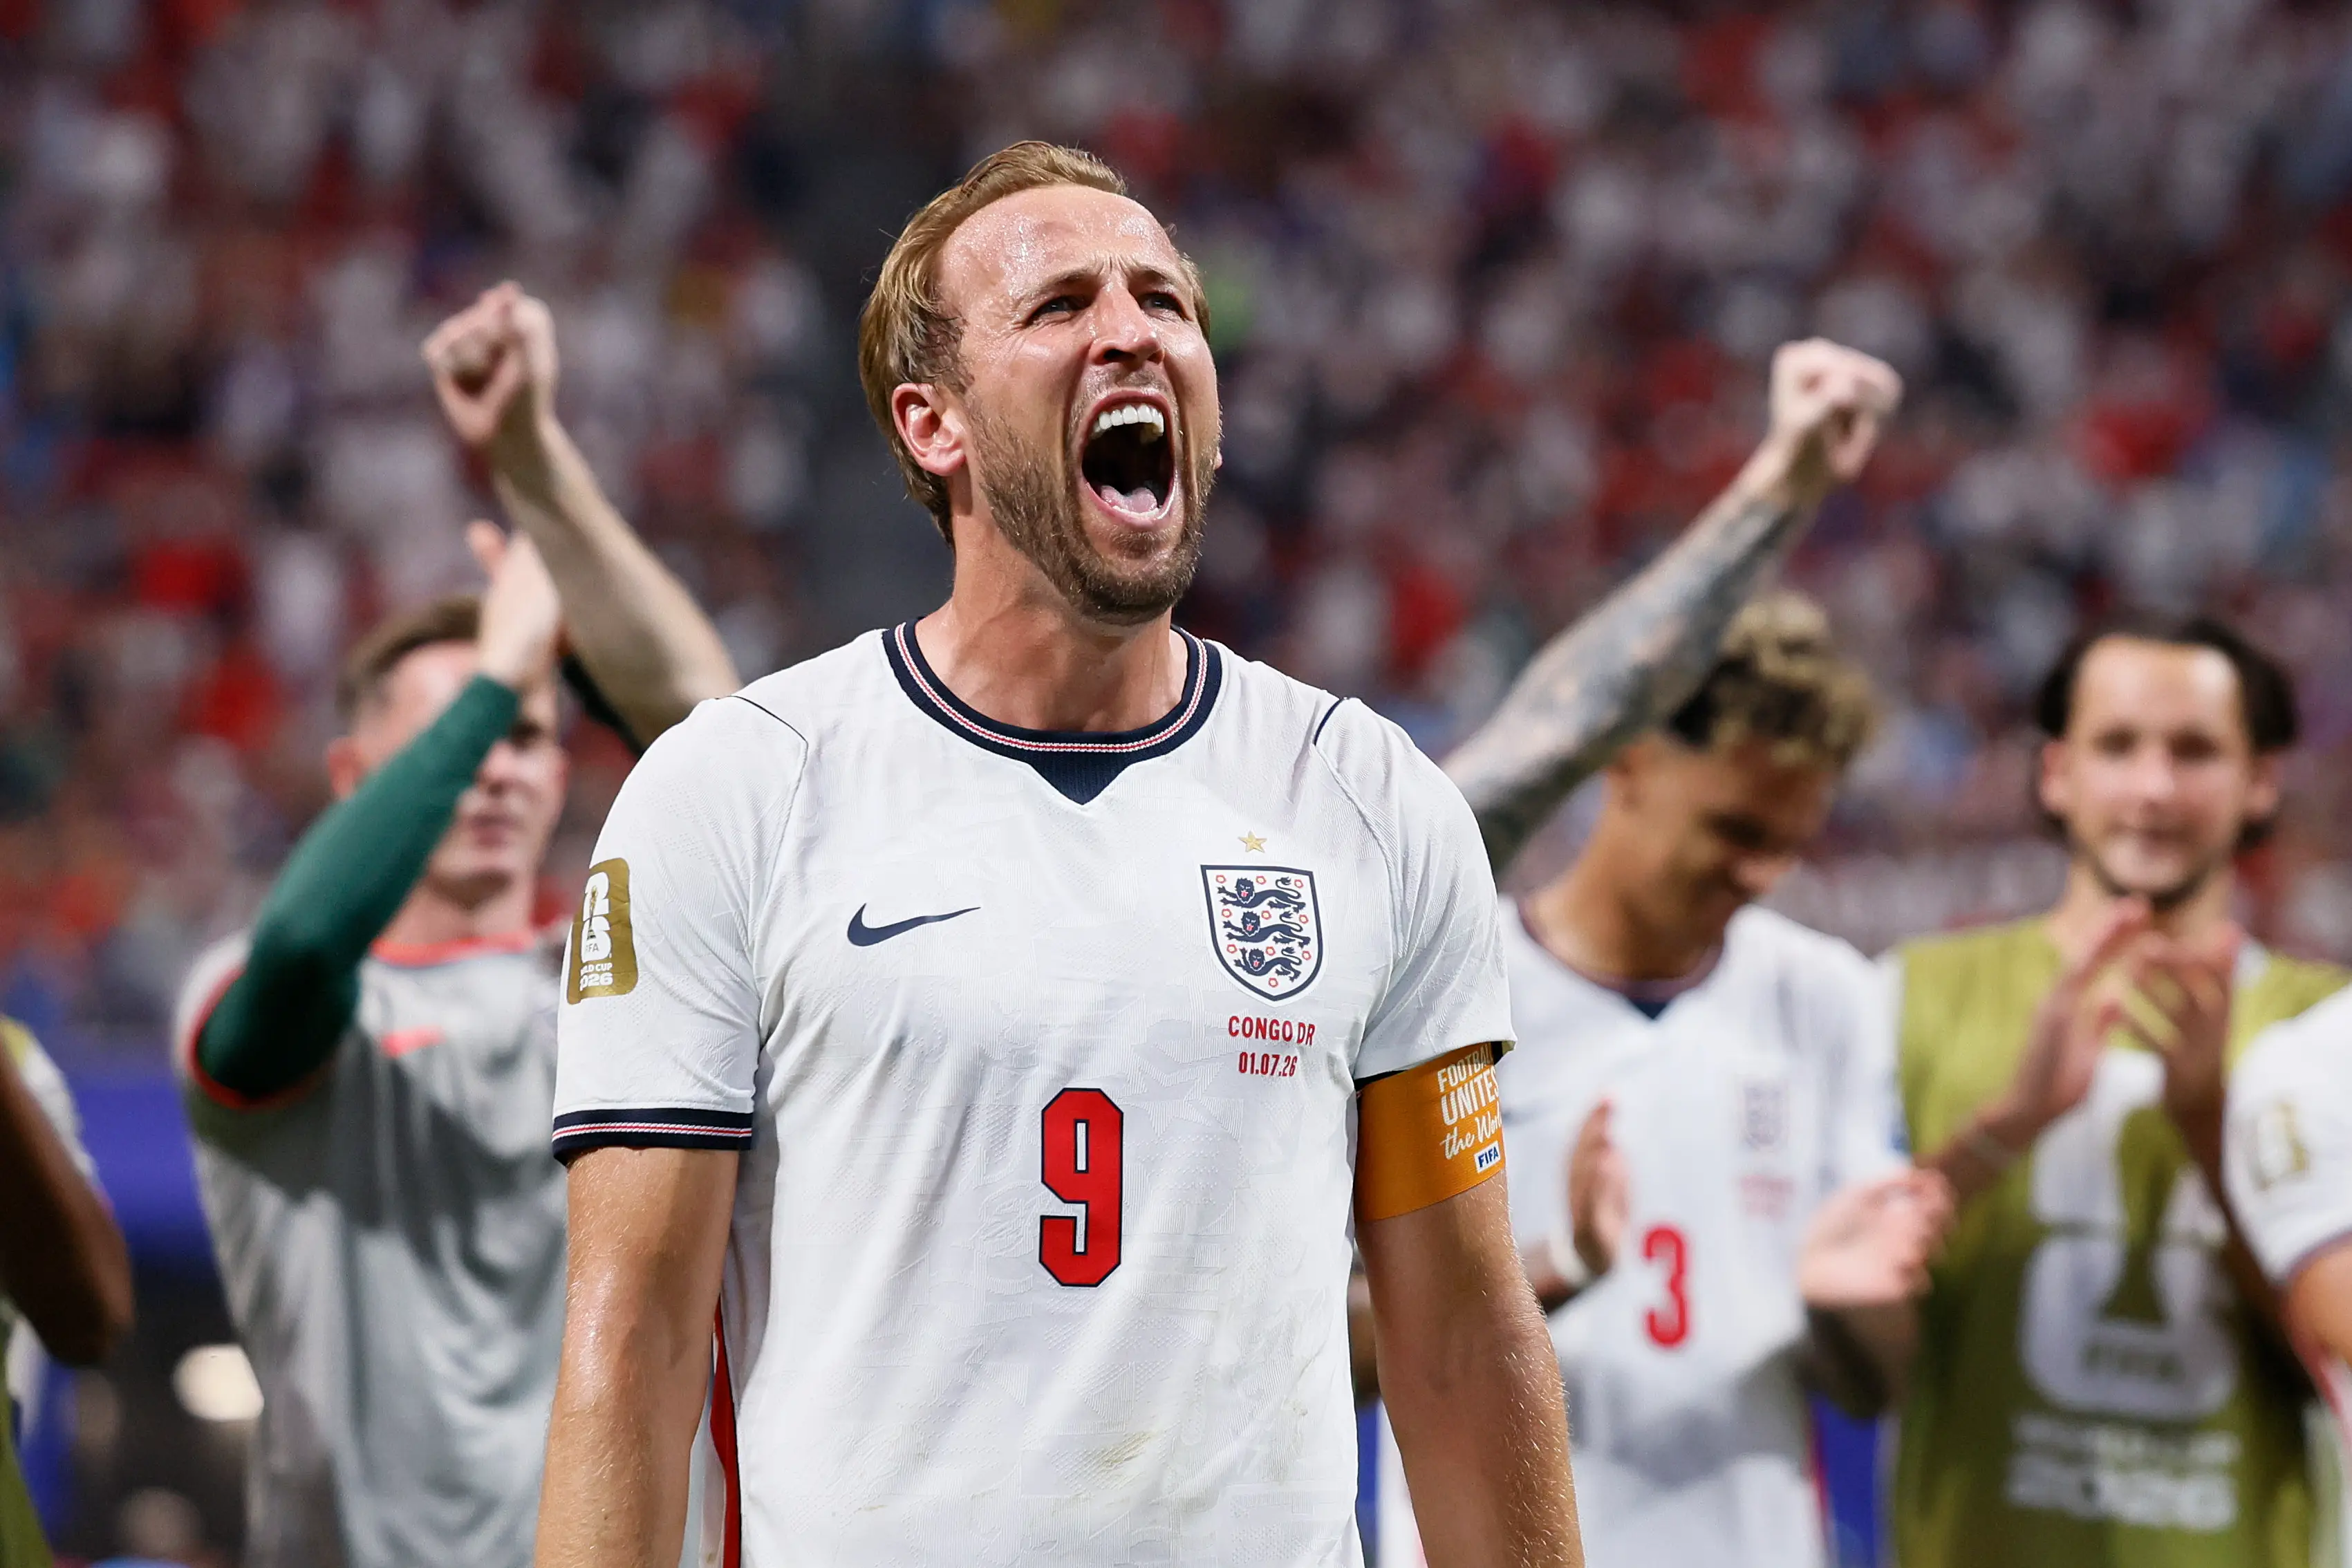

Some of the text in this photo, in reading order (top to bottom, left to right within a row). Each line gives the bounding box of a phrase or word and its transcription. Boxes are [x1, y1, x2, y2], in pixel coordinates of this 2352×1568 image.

[580, 972, 613, 991] 026
[595, 962, 613, 972] CUP
[1229, 1016, 1316, 1045] CONGO DR
[1239, 1052, 1298, 1076] 01.07.26
[1441, 1065, 1498, 1126] UNITES
[1439, 1101, 1502, 1160] the Worl
[1478, 1146, 1499, 1168] FIFA
[1039, 1088, 1123, 1287] 9
[1643, 1224, 1688, 1348] 3
